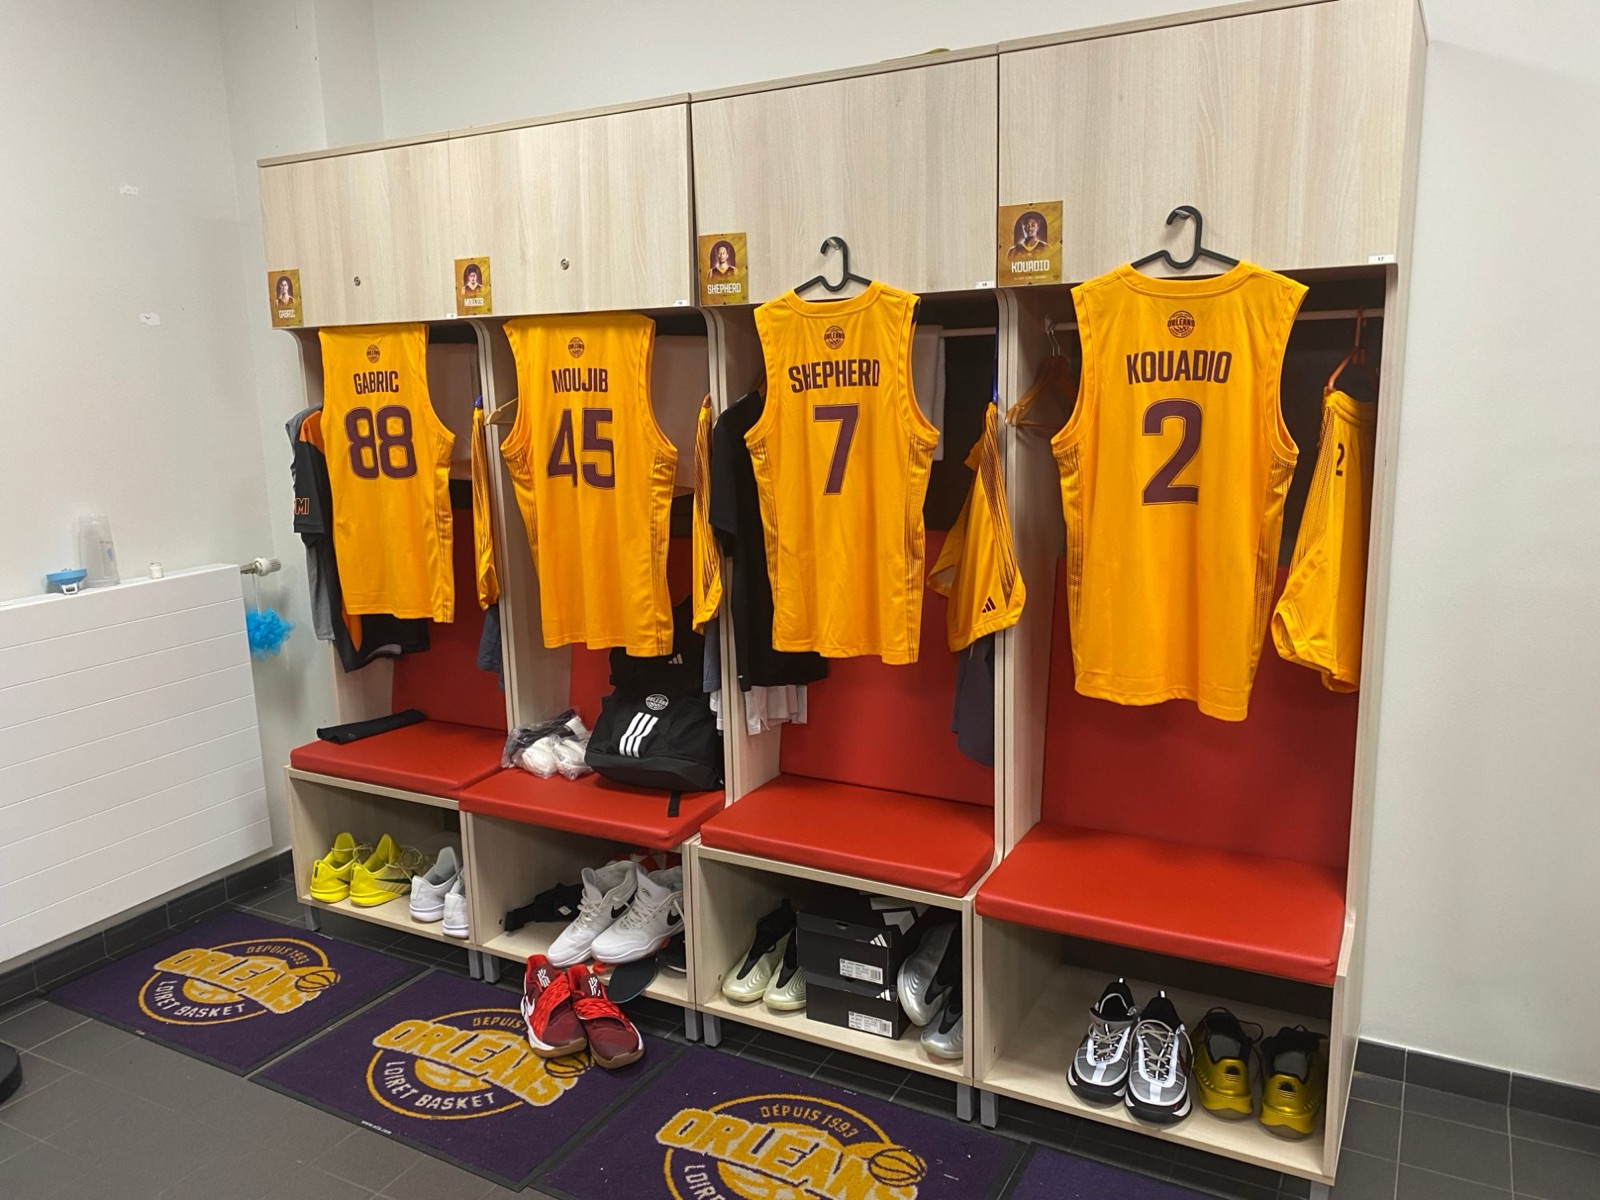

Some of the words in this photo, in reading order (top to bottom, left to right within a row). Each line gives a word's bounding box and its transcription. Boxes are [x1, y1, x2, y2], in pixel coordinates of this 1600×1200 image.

[1011, 260, 1050, 274] KOUADIO
[707, 282, 742, 295] SHEPHERD
[353, 370, 400, 394] GABRIC
[551, 367, 608, 393] MOUJIB
[788, 358, 880, 393] SHEPHERD
[1126, 349, 1232, 385] KOUADIO
[343, 404, 418, 480] 88
[545, 407, 616, 490] 45
[812, 403, 860, 496] 7
[1142, 398, 1203, 506] 2
[1335, 442, 1346, 477] 2
[246, 944, 293, 956] DEPUIS
[154, 979, 178, 1011] LOIRET
[173, 1003, 246, 1018] BASKET
[473, 1016, 522, 1029] DEPUIS
[384, 1060, 418, 1100] LOIRET
[415, 1091, 495, 1111] BASKET
[759, 1104, 820, 1122] DEPUIS
[821, 1113, 860, 1139] 1993
[683, 1164, 727, 1200] LOIR
